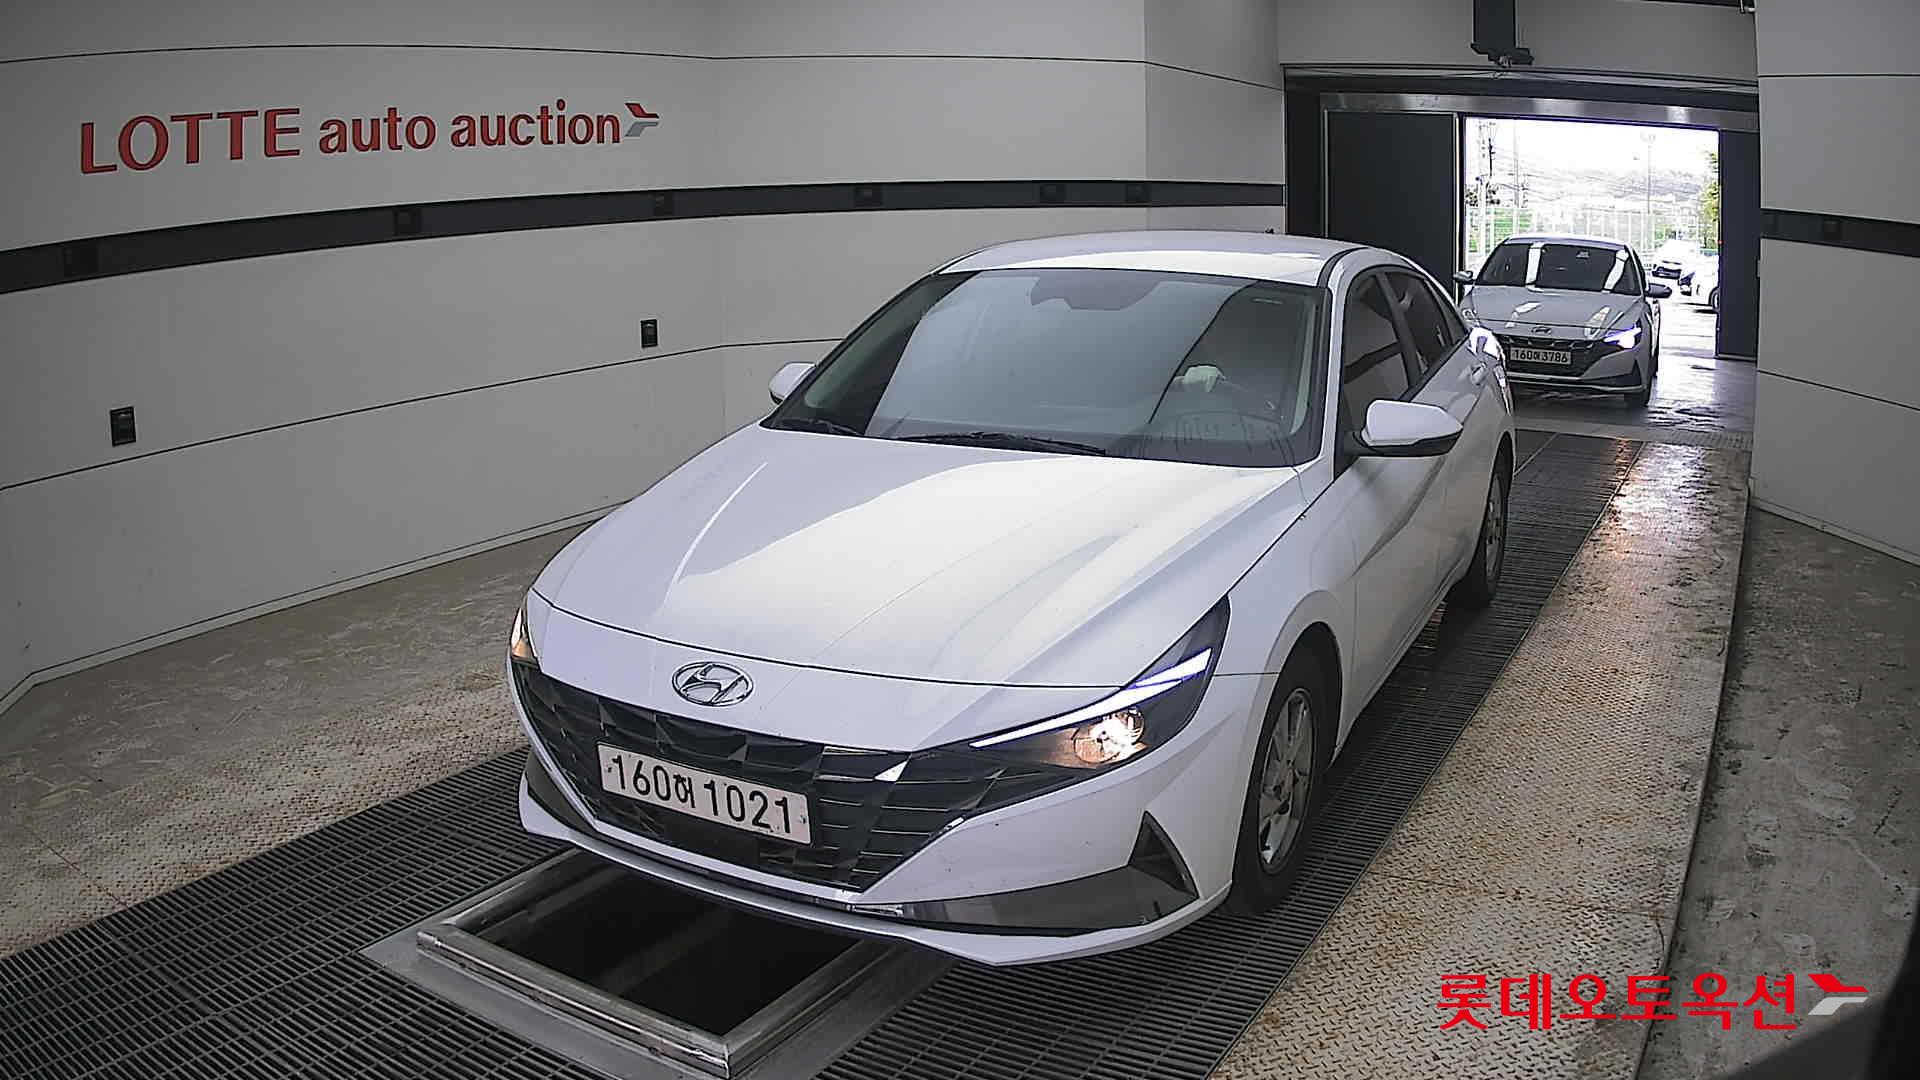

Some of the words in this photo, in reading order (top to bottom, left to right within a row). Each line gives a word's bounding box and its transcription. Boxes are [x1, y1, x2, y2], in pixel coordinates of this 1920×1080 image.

[81, 106, 301, 174] LOTTE
[318, 107, 438, 154] auto
[450, 99, 622, 147] auction
